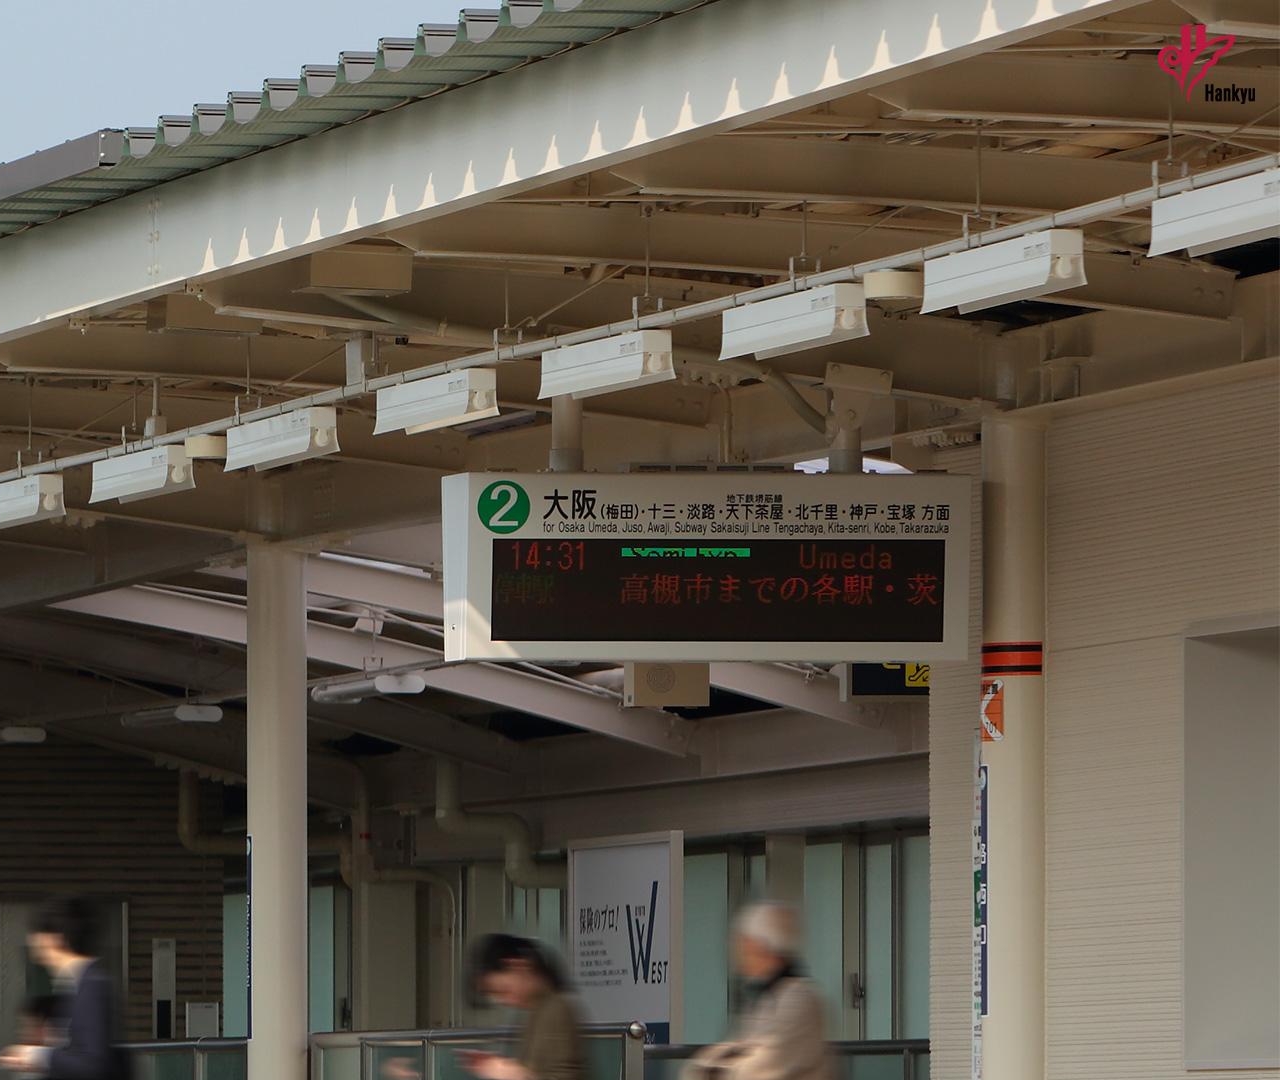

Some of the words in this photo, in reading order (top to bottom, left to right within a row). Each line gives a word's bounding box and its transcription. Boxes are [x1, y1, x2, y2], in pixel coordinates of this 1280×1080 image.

[489, 484, 519, 527] 2
[922, 504, 950, 520] 方面
[543, 522, 555, 533] for
[558, 522, 585, 533] Osaka
[589, 522, 620, 533] Umeda,
[622, 522, 645, 533] Juso,
[647, 522, 671, 534] Awaji,
[675, 522, 707, 535] Subway
[711, 522, 749, 535] Sakaisuji
[752, 522, 770, 533] Line
[774, 522, 825, 535] Tengachaya,
[828, 522, 871, 533] Kita-senri,
[874, 522, 898, 533] Kobe,
[900, 522, 949, 533] Takarazuka
[511, 541, 585, 571] 14:31
[798, 543, 894, 570] Umeda
